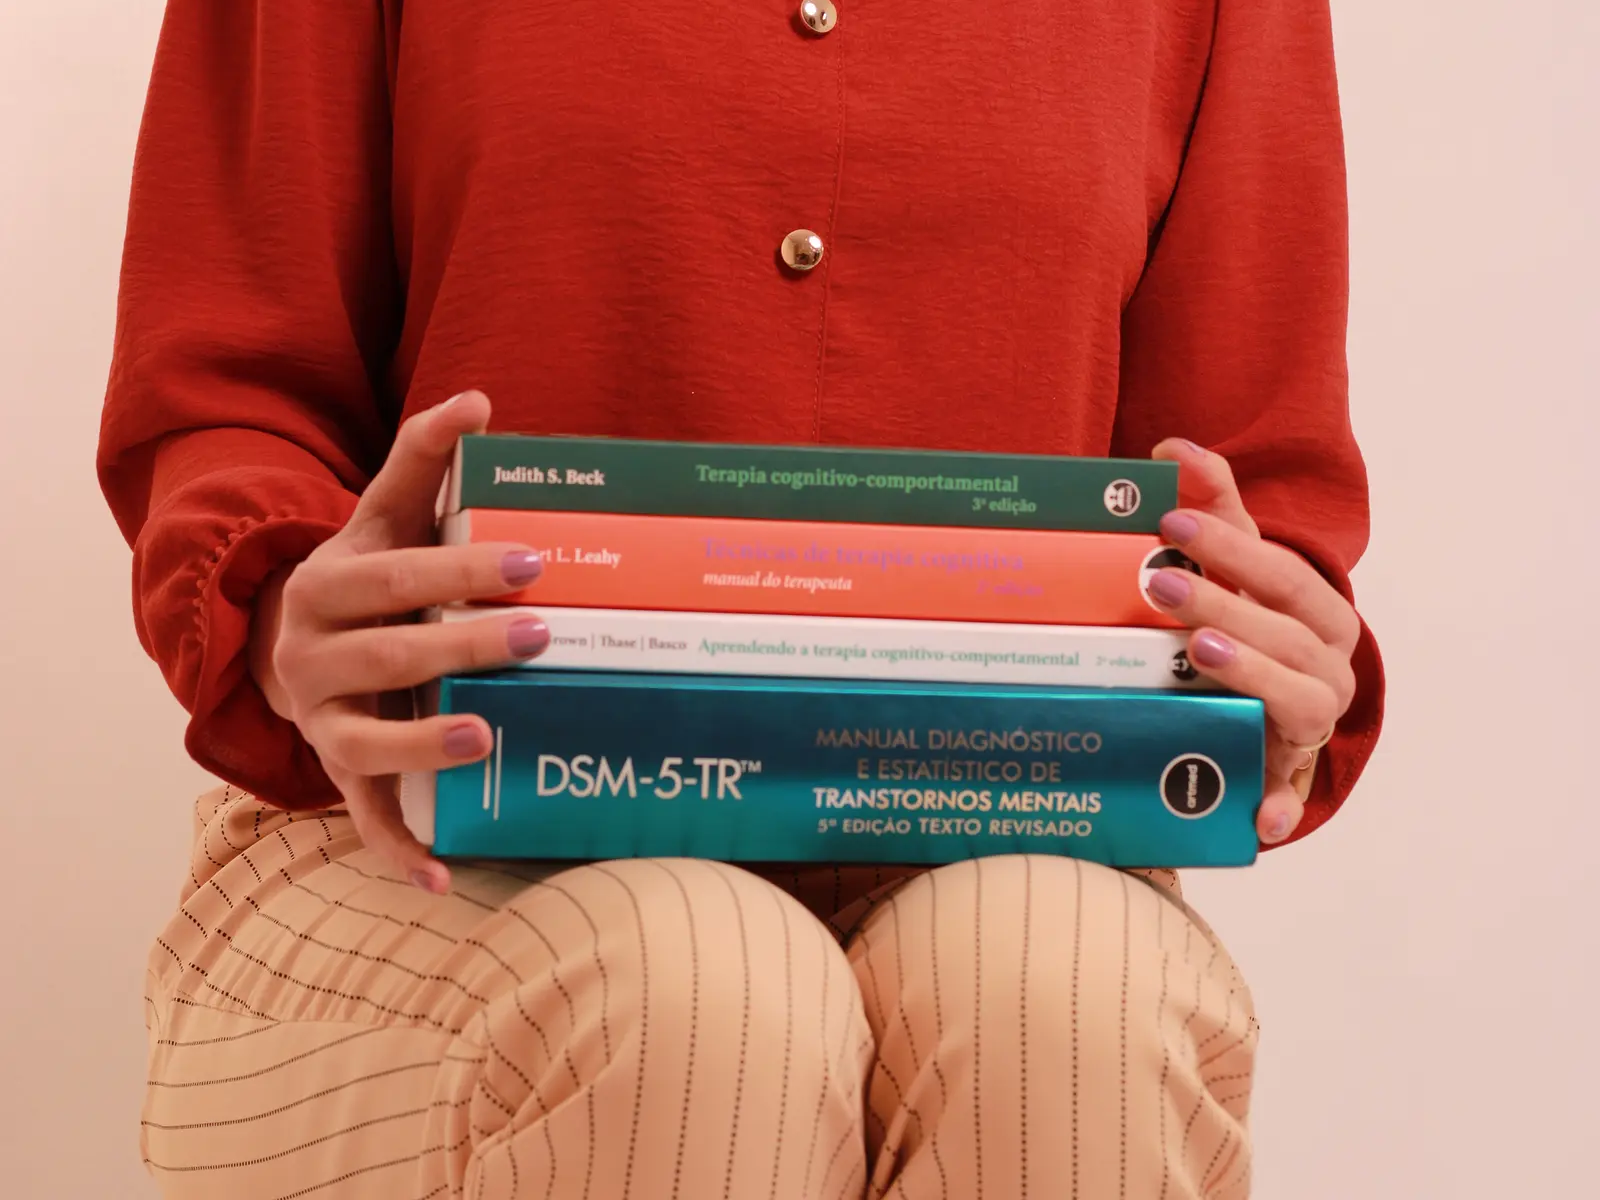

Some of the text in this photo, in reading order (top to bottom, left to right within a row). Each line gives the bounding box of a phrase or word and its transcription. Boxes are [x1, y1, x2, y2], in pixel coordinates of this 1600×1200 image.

[494, 467, 605, 486] Judith S. Beck
[696, 465, 1019, 494] Terapia cognitivo-comportamental
[989, 498, 1037, 515] edição
[556, 547, 571, 563] L.
[574, 548, 622, 569] Leahy
[702, 538, 1024, 573] Técnicas de terapia cognitiva
[703, 571, 852, 593] manual do terapeuta
[549, 636, 687, 650] rown Thase Basco
[698, 638, 1080, 667] Aprendendo a terapia cognitivo-comportamental
[1109, 657, 1146, 668] edição
[816, 726, 1102, 753] MANUAL DIAGNÓSTICO
[857, 757, 1061, 782] E ESTATÍSTICO DE
[1186, 764, 1198, 809] artmed
[813, 788, 1101, 813] TRANSTORNOS MENTAIS
[842, 817, 911, 836] EDIÇÃO
[919, 818, 981, 835] TEXTO
[988, 819, 1093, 837] REVISADO
